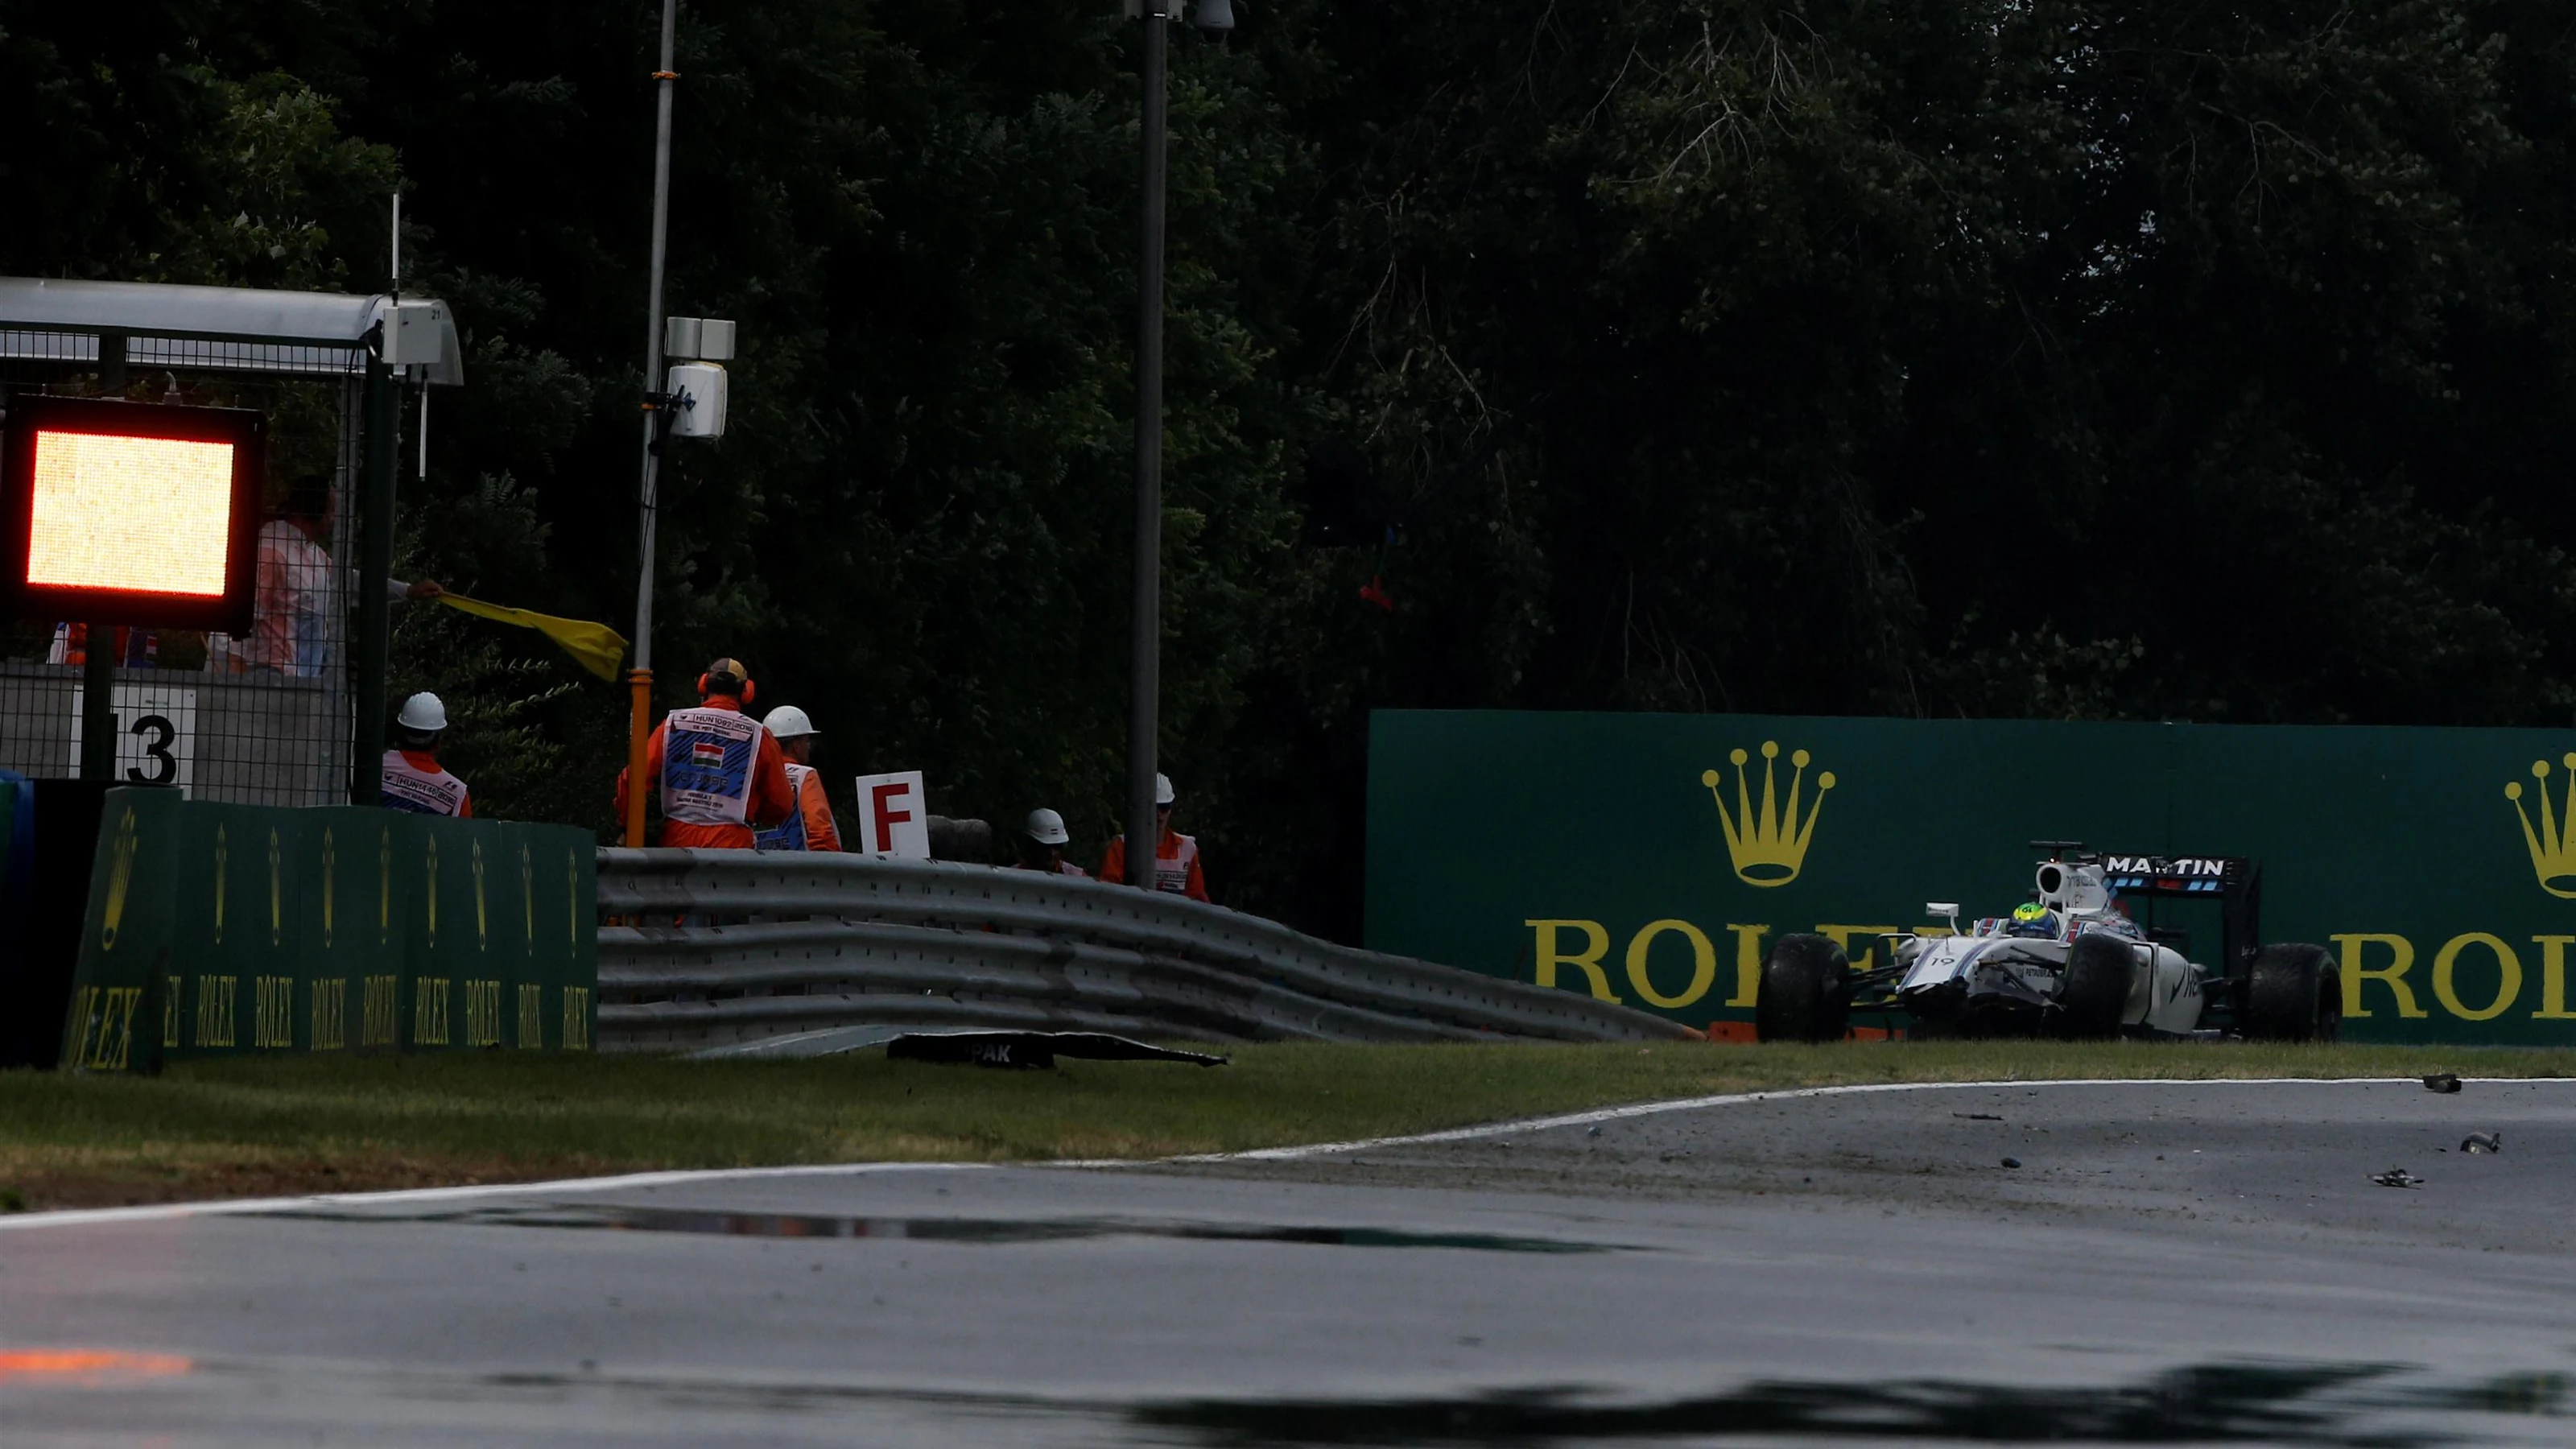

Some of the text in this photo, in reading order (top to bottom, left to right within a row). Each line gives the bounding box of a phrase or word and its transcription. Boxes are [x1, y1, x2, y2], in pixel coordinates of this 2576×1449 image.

[431, 309, 440, 320] 21
[872, 782, 911, 852] F
[1525, 919, 1972, 1009] ROLE
[1931, 958, 1955, 967] 19
[196, 974, 237, 1048] ROLEX
[254, 974, 293, 1050] ROLEX
[311, 977, 346, 1052] ROLEX
[414, 976, 450, 1046] ROLEX
[465, 976, 501, 1047] ROLEX
